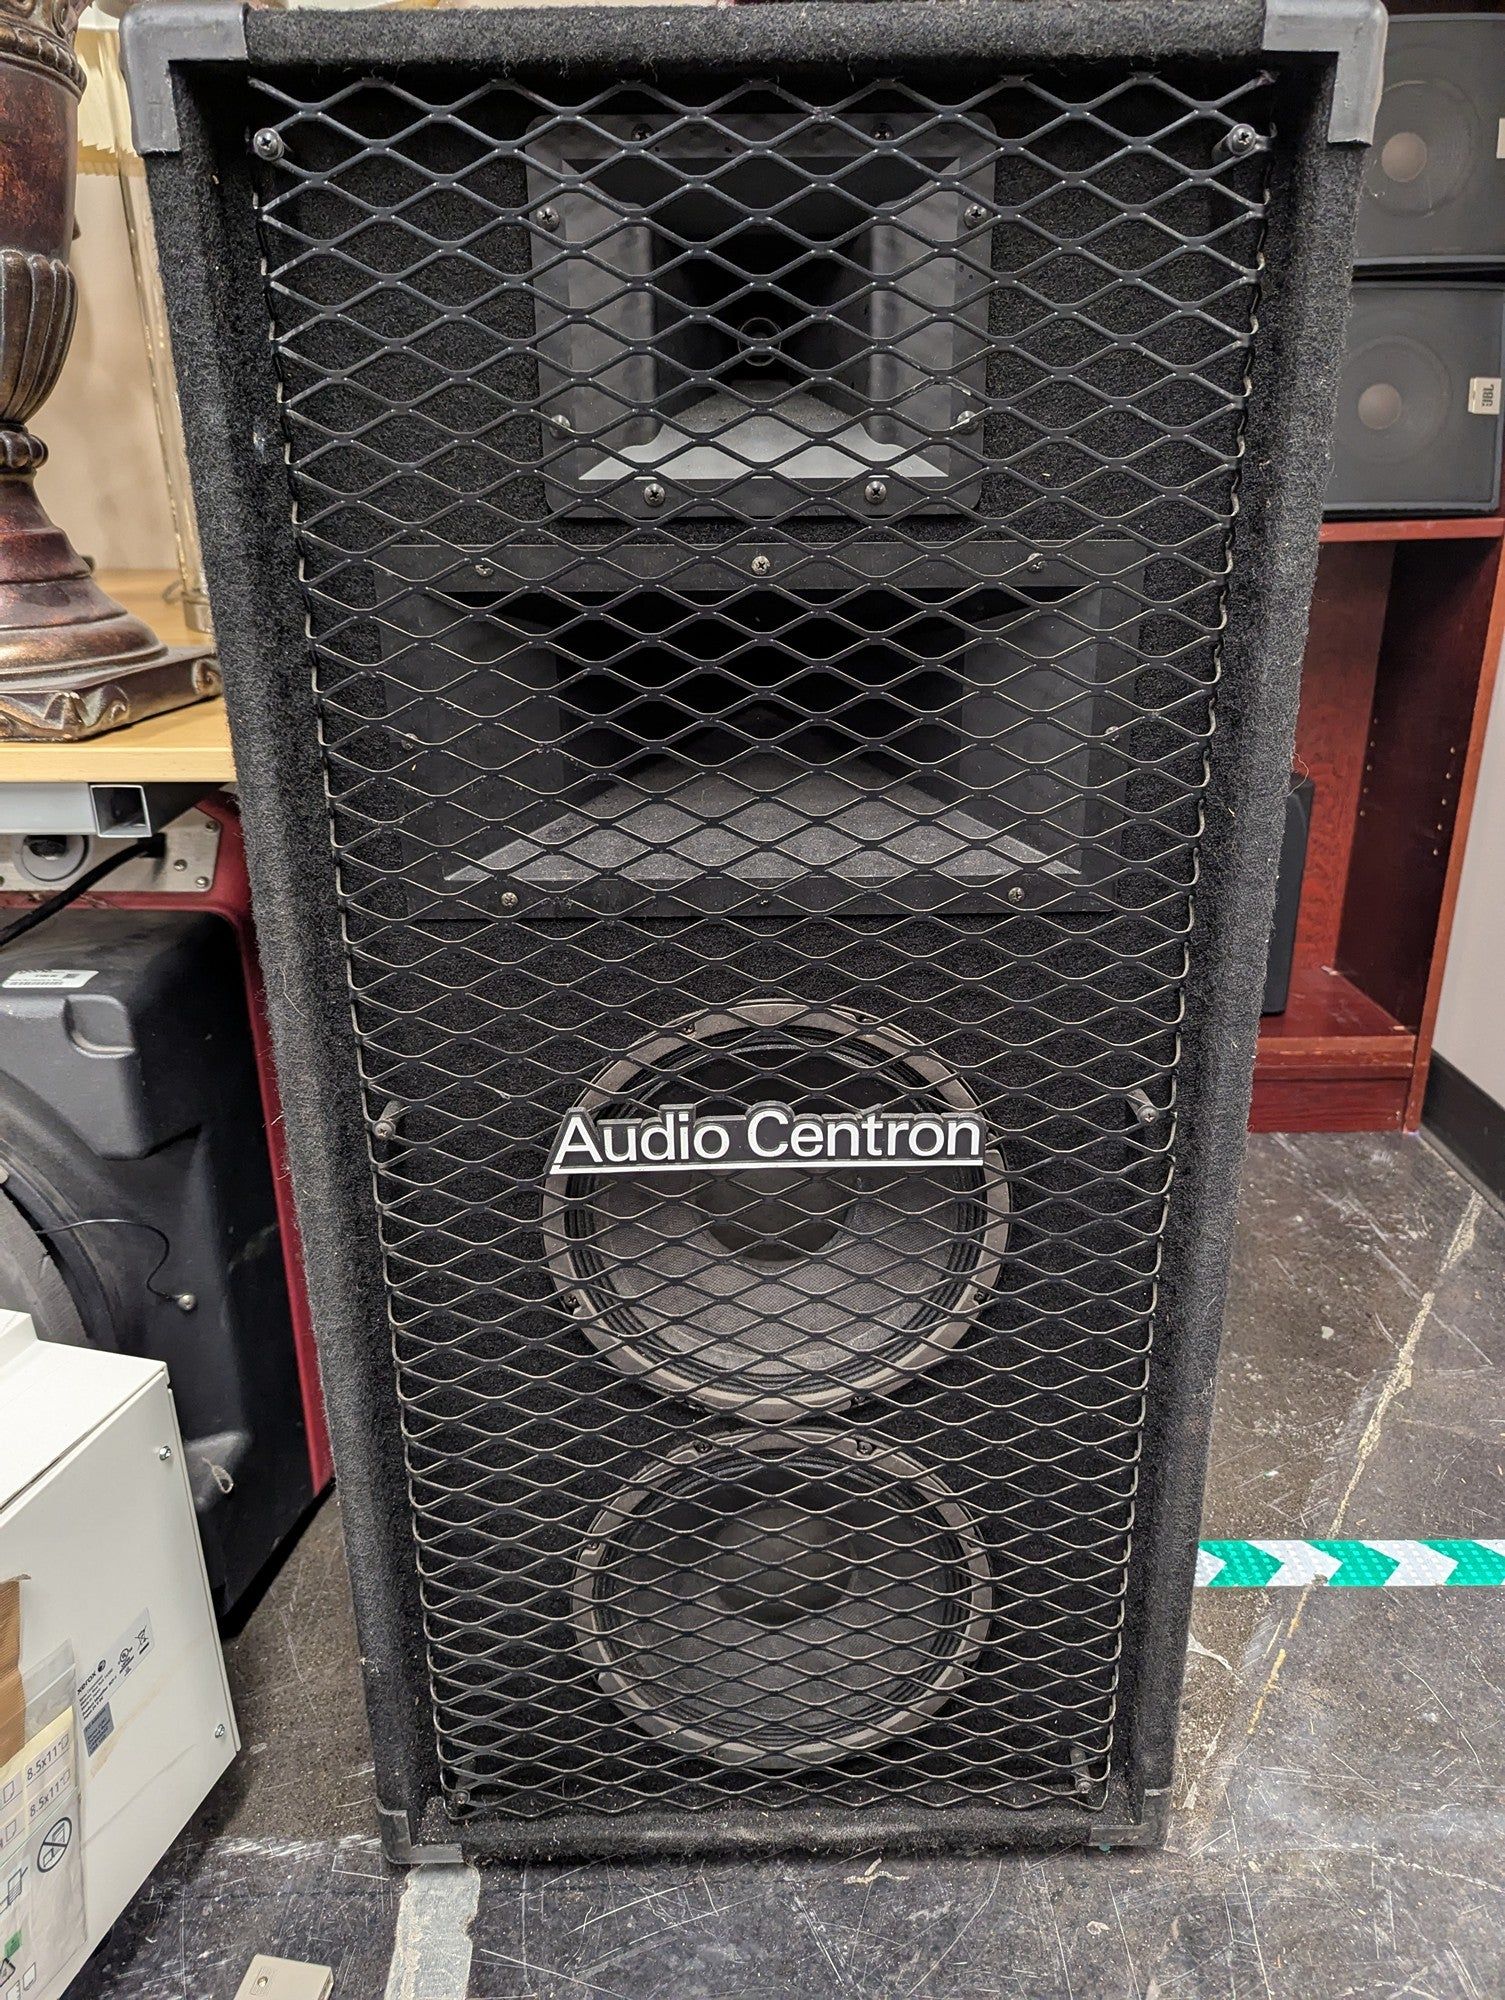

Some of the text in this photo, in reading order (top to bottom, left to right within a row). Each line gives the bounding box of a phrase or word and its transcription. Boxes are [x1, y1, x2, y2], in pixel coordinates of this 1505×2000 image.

[1482, 384, 1494, 406] JBL
[556, 1109, 982, 1163] Audio Centron
[77, 1671, 96, 1695] xerox
